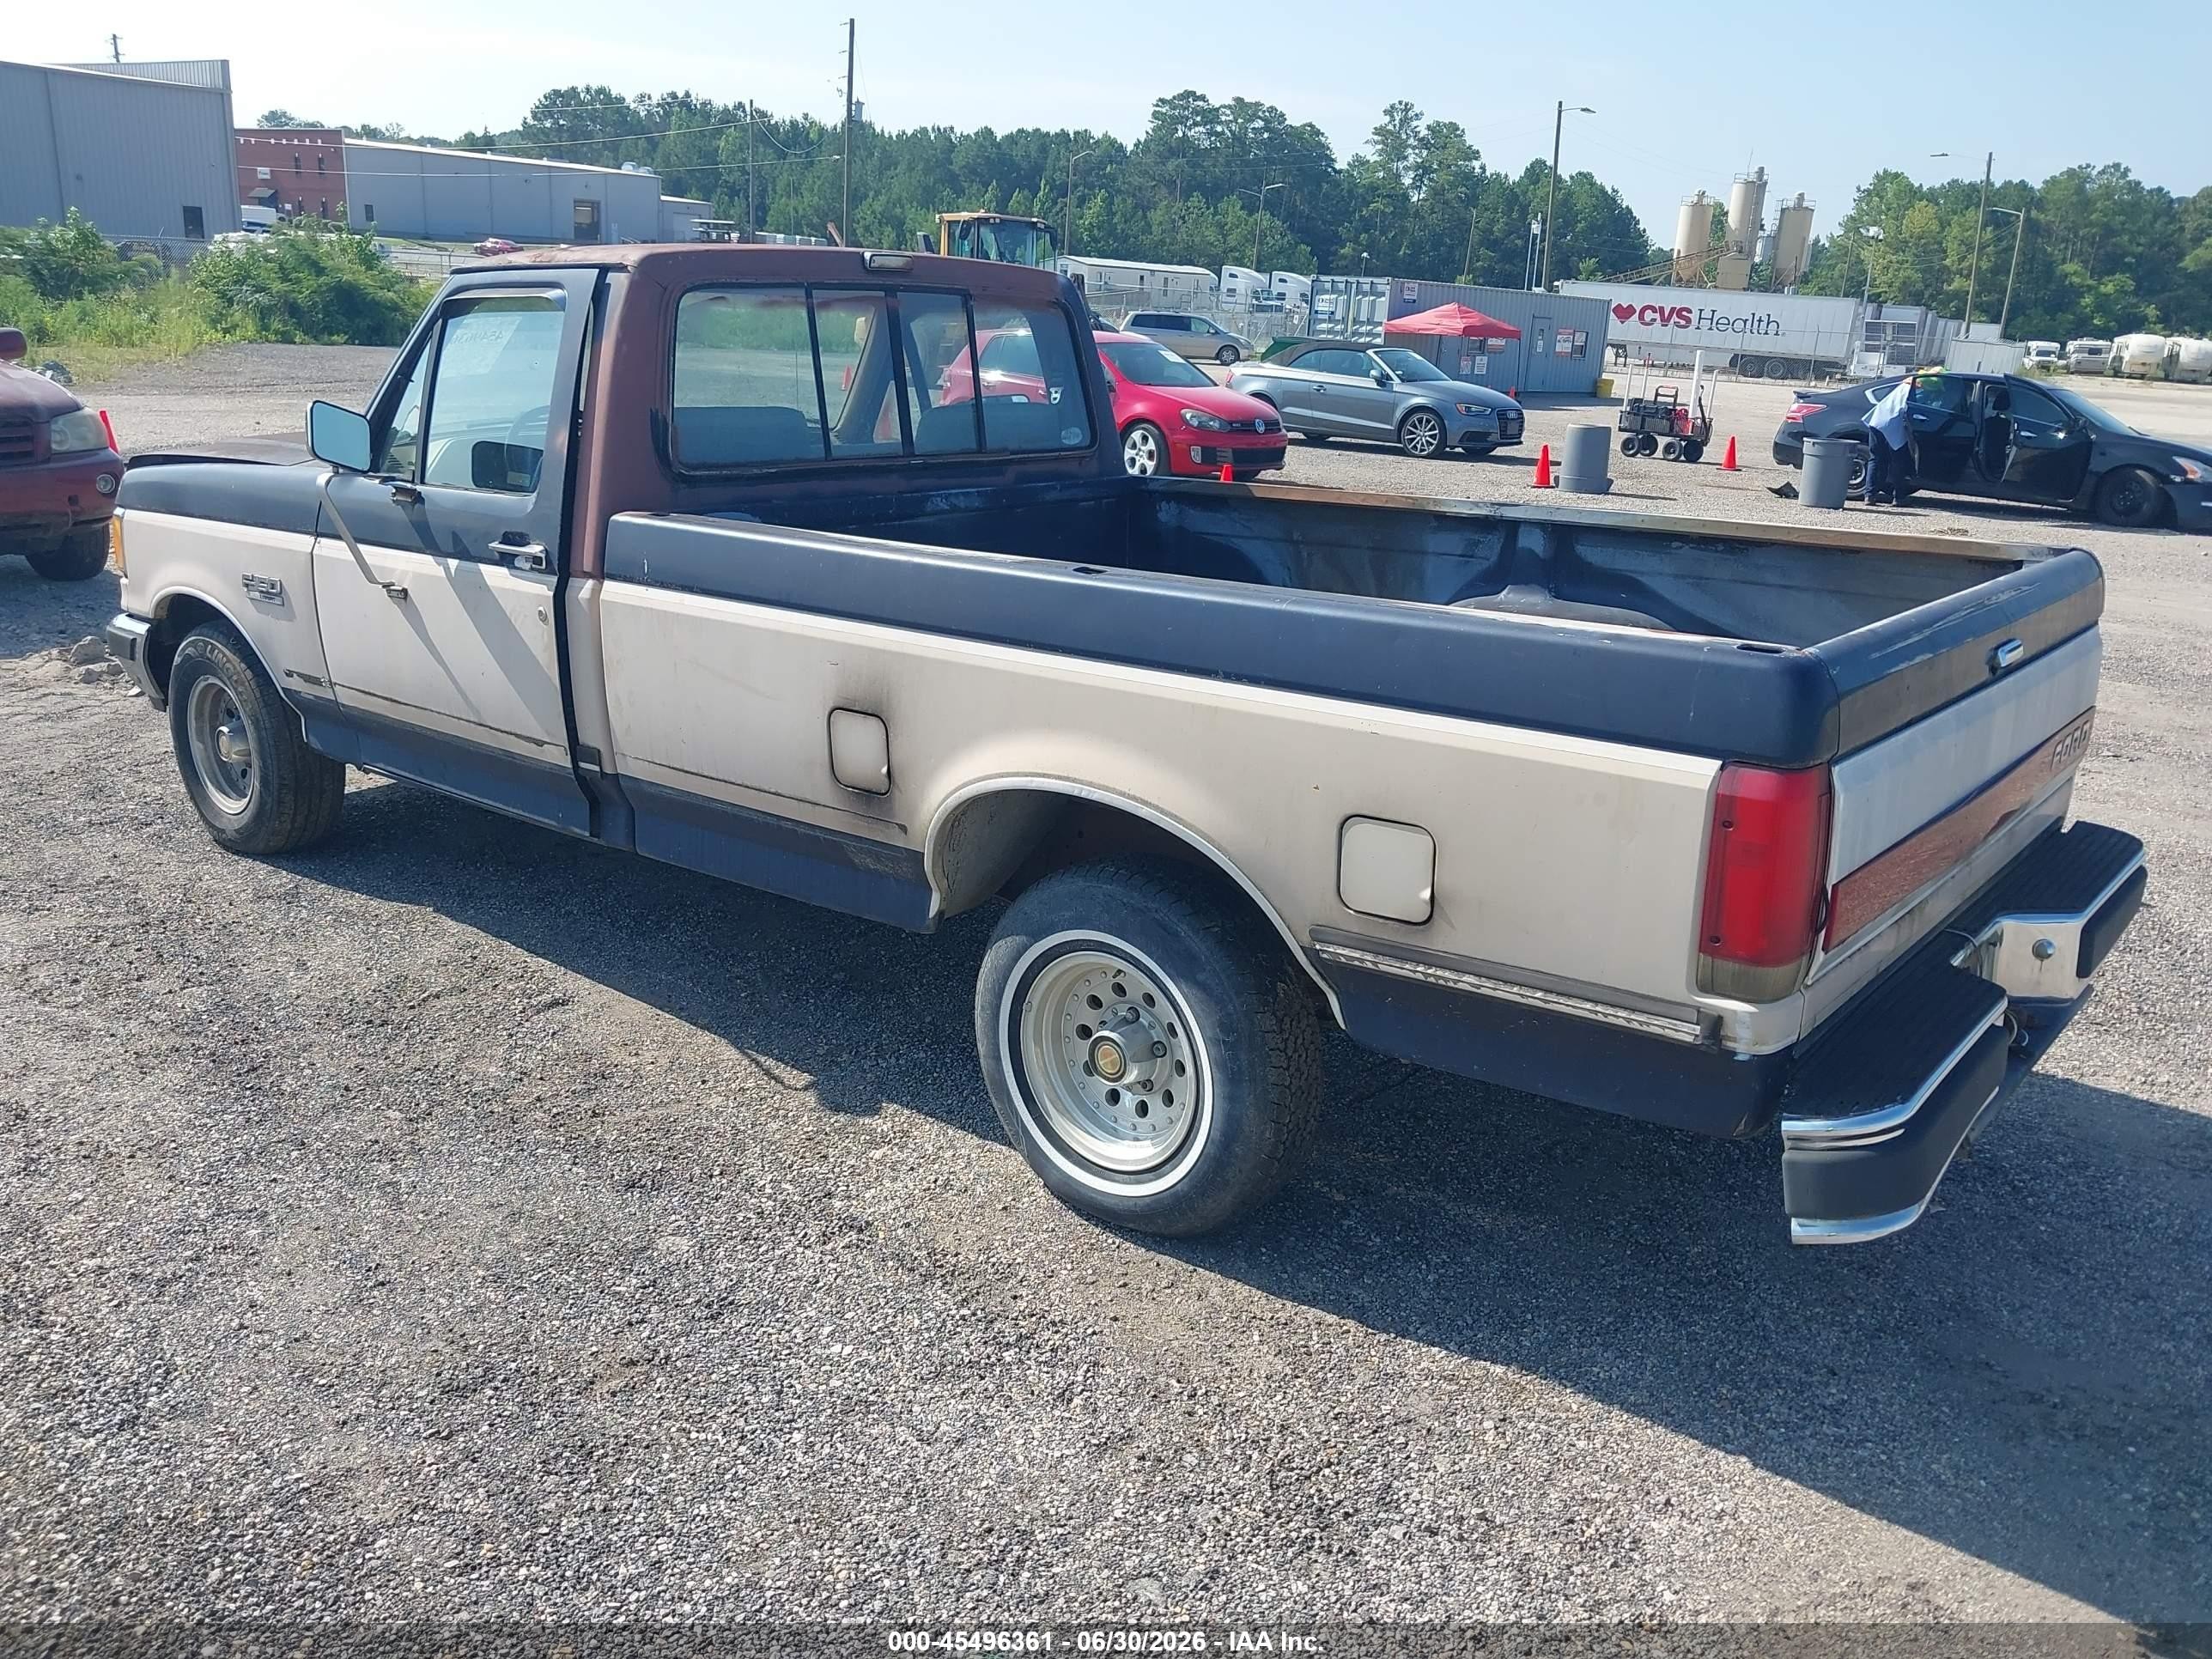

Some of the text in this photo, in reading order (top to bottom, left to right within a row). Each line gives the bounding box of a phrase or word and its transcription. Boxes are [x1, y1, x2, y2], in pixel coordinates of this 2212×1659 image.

[1638, 304, 1781, 337] CVS Health
[2050, 720, 2090, 772] FORD
